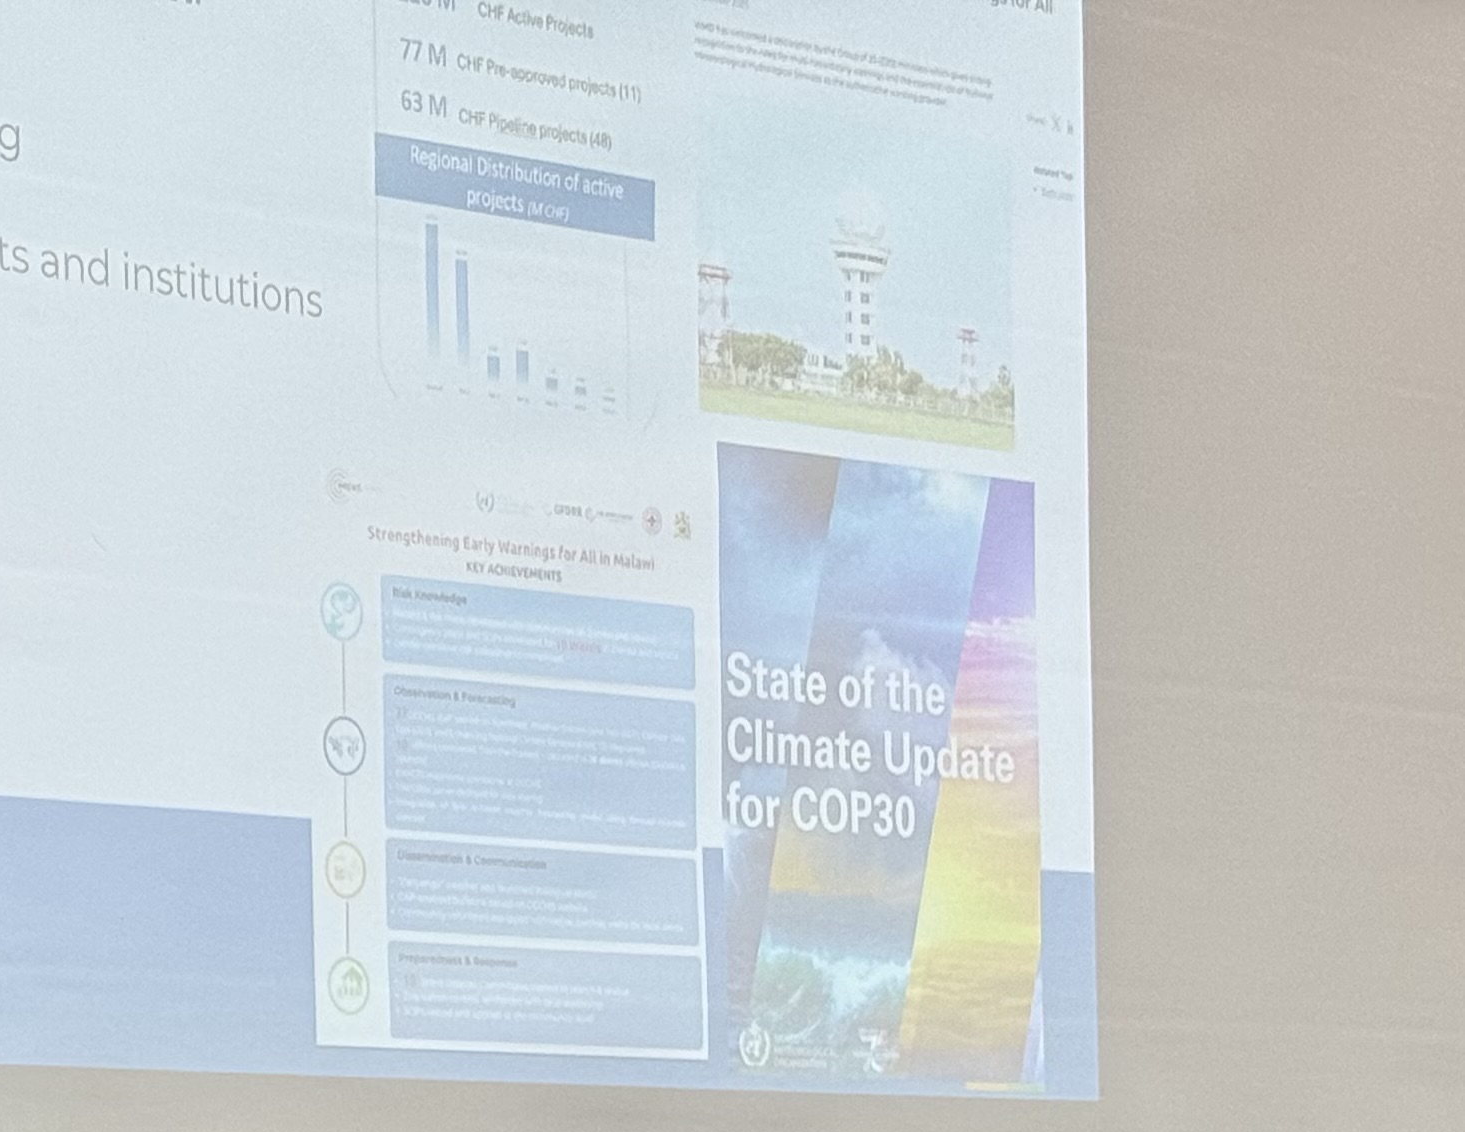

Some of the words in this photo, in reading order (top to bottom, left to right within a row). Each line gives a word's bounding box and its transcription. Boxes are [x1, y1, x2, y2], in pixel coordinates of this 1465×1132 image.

[477, 2, 504, 21] CHF
[507, 7, 544, 30] Active
[545, 14, 595, 40] Projects
[399, 37, 423, 62] 77
[428, 43, 447, 67] M
[456, 53, 485, 72] CHF
[486, 58, 567, 90] Pre-approved
[568, 76, 617, 99] projects
[618, 83, 642, 104] (11)
[400, 89, 423, 114] 63
[428, 94, 447, 118] M
[458, 107, 486, 127] CHF
[488, 112, 537, 136] Pipeline
[539, 122, 588, 147] projects
[589, 128, 613, 151] (48)
[410, 143, 474, 177] Regional
[477, 155, 561, 190] Distribution
[564, 173, 581, 192] of
[582, 177, 624, 201] active
[466, 188, 525, 214] projects
[39, 248, 110, 288] and
[123, 250, 324, 318] institutions
[366, 524, 460, 553] Strengthening
[463, 536, 495, 558] Early
[498, 540, 556, 564] Warnings
[558, 545, 577, 563] for
[580, 549, 598, 566] All
[613, 552, 656, 572] Malawi
[465, 561, 485, 575] KEY
[487, 563, 563, 583] ACHIEVEMENTS
[726, 650, 827, 707] State
[838, 666, 876, 709] of
[885, 668, 946, 716] the
[727, 716, 872, 773] Climate
[884, 729, 1015, 787] Update
[726, 780, 780, 828] for
[791, 786, 916, 839] COP30
